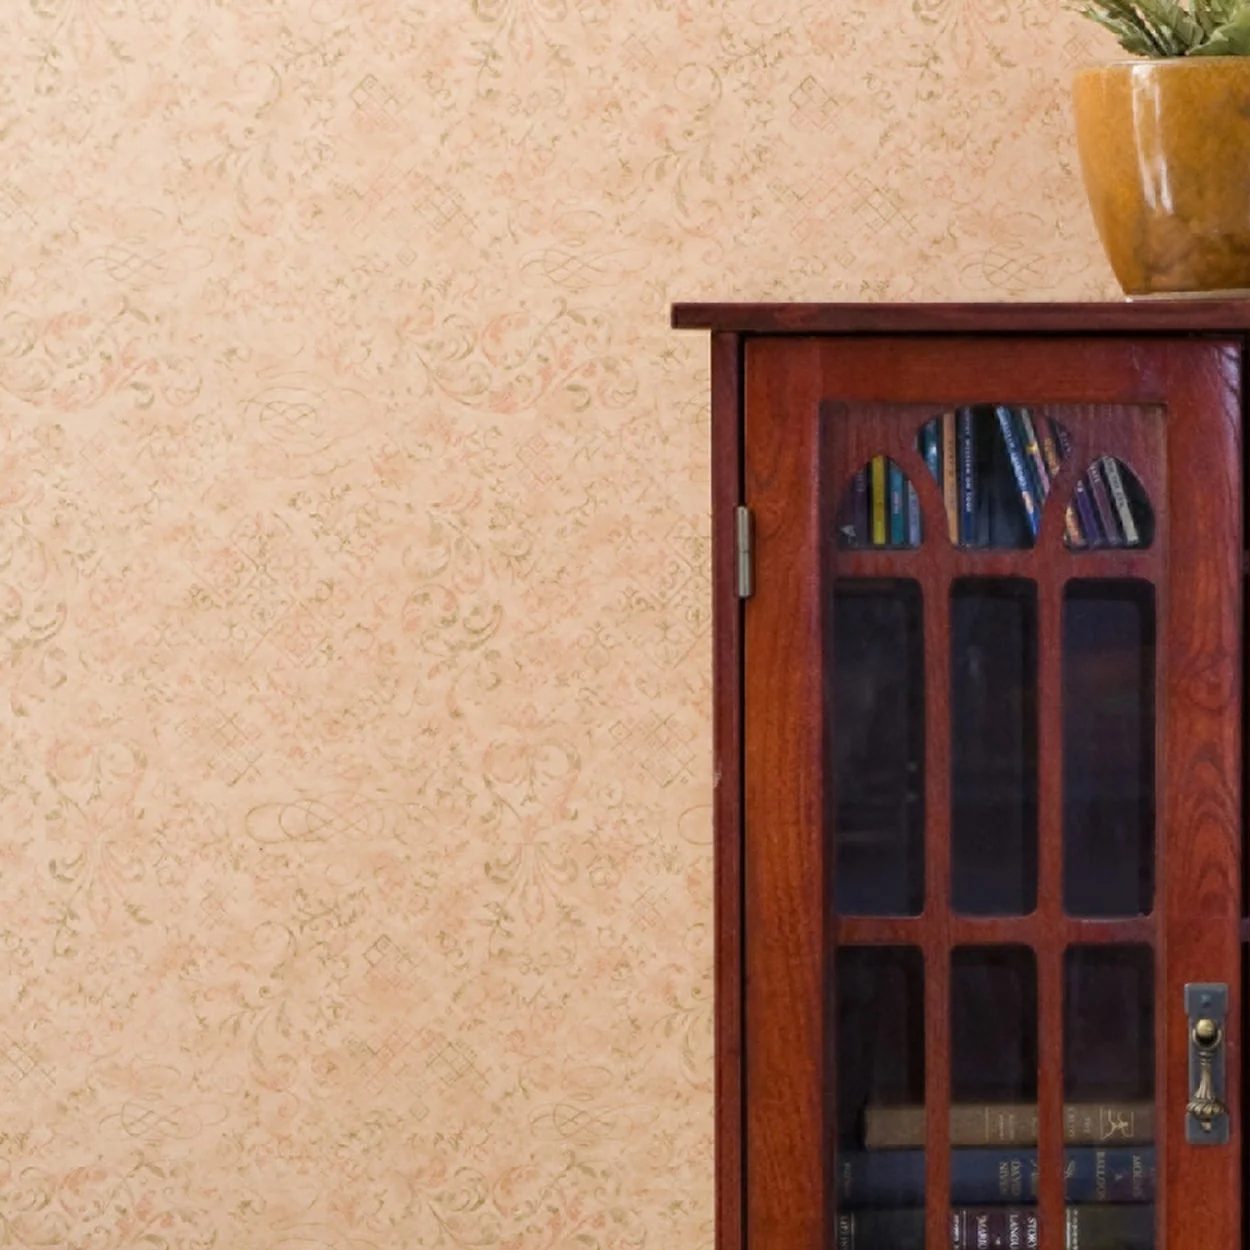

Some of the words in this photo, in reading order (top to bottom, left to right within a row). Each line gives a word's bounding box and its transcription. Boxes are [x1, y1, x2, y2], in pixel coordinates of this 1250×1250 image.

[1010, 1160, 1021, 1196] DAVID
[977, 1215, 988, 1250] MARIO
[1027, 1216, 1037, 1249] STORY
